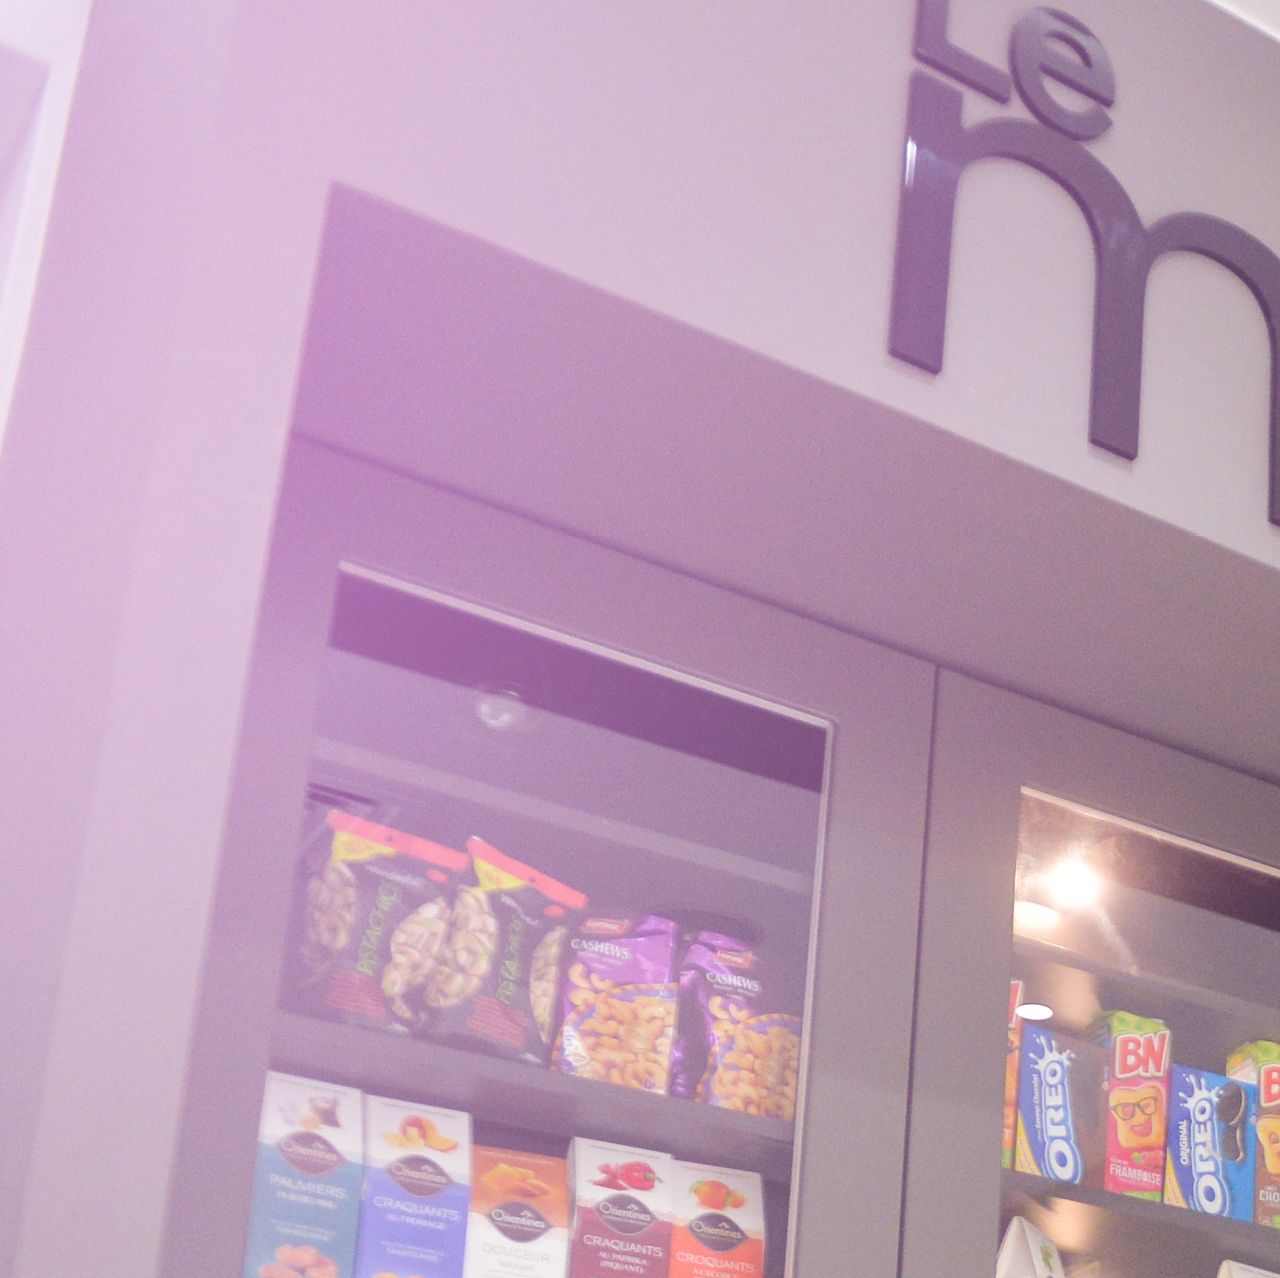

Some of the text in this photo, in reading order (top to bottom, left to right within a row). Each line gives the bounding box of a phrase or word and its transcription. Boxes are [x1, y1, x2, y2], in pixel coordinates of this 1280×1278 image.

[912, 0, 1115, 141] Le
[571, 938, 631, 960] CASHEWS
[1118, 1031, 1168, 1077] BN
[1045, 1062, 1075, 1181] OREO
[1179, 1119, 1189, 1165] ORIGINAL
[1194, 1099, 1222, 1215] OREO
[373, 1196, 460, 1221] CRAQUANTS
[600, 1202, 652, 1222] Orientines
[583, 1234, 664, 1257] CRAQUANTS
[676, 1251, 756, 1274] CROQUANTS
